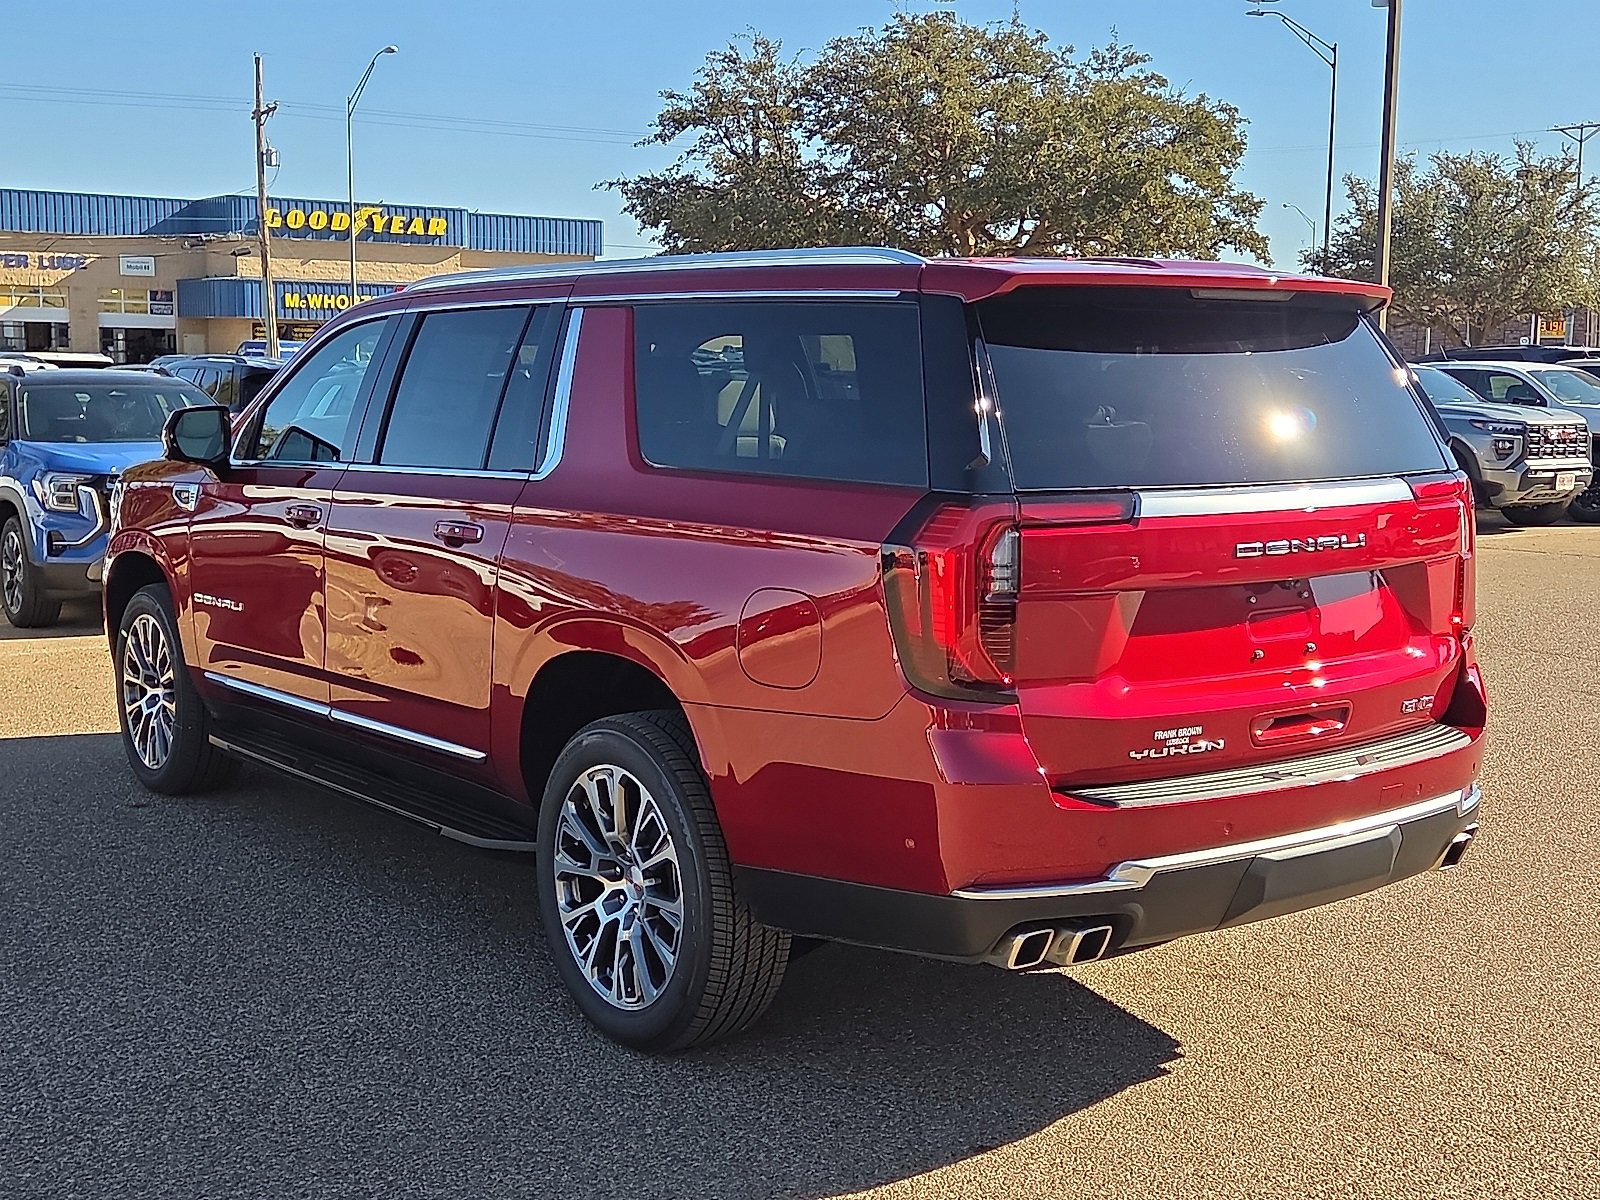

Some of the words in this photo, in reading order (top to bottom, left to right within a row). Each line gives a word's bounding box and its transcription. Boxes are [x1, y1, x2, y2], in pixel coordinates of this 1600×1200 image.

[266, 208, 447, 236] GOODYEAR
[0, 254, 28, 268] ER
[38, 255, 87, 270] LUBE
[1236, 532, 1366, 558] DENALI
[193, 592, 244, 612] DENALI
[1154, 729, 1177, 740] FRANK
[1177, 726, 1203, 737] BROWN
[1129, 739, 1225, 760] YUKON
